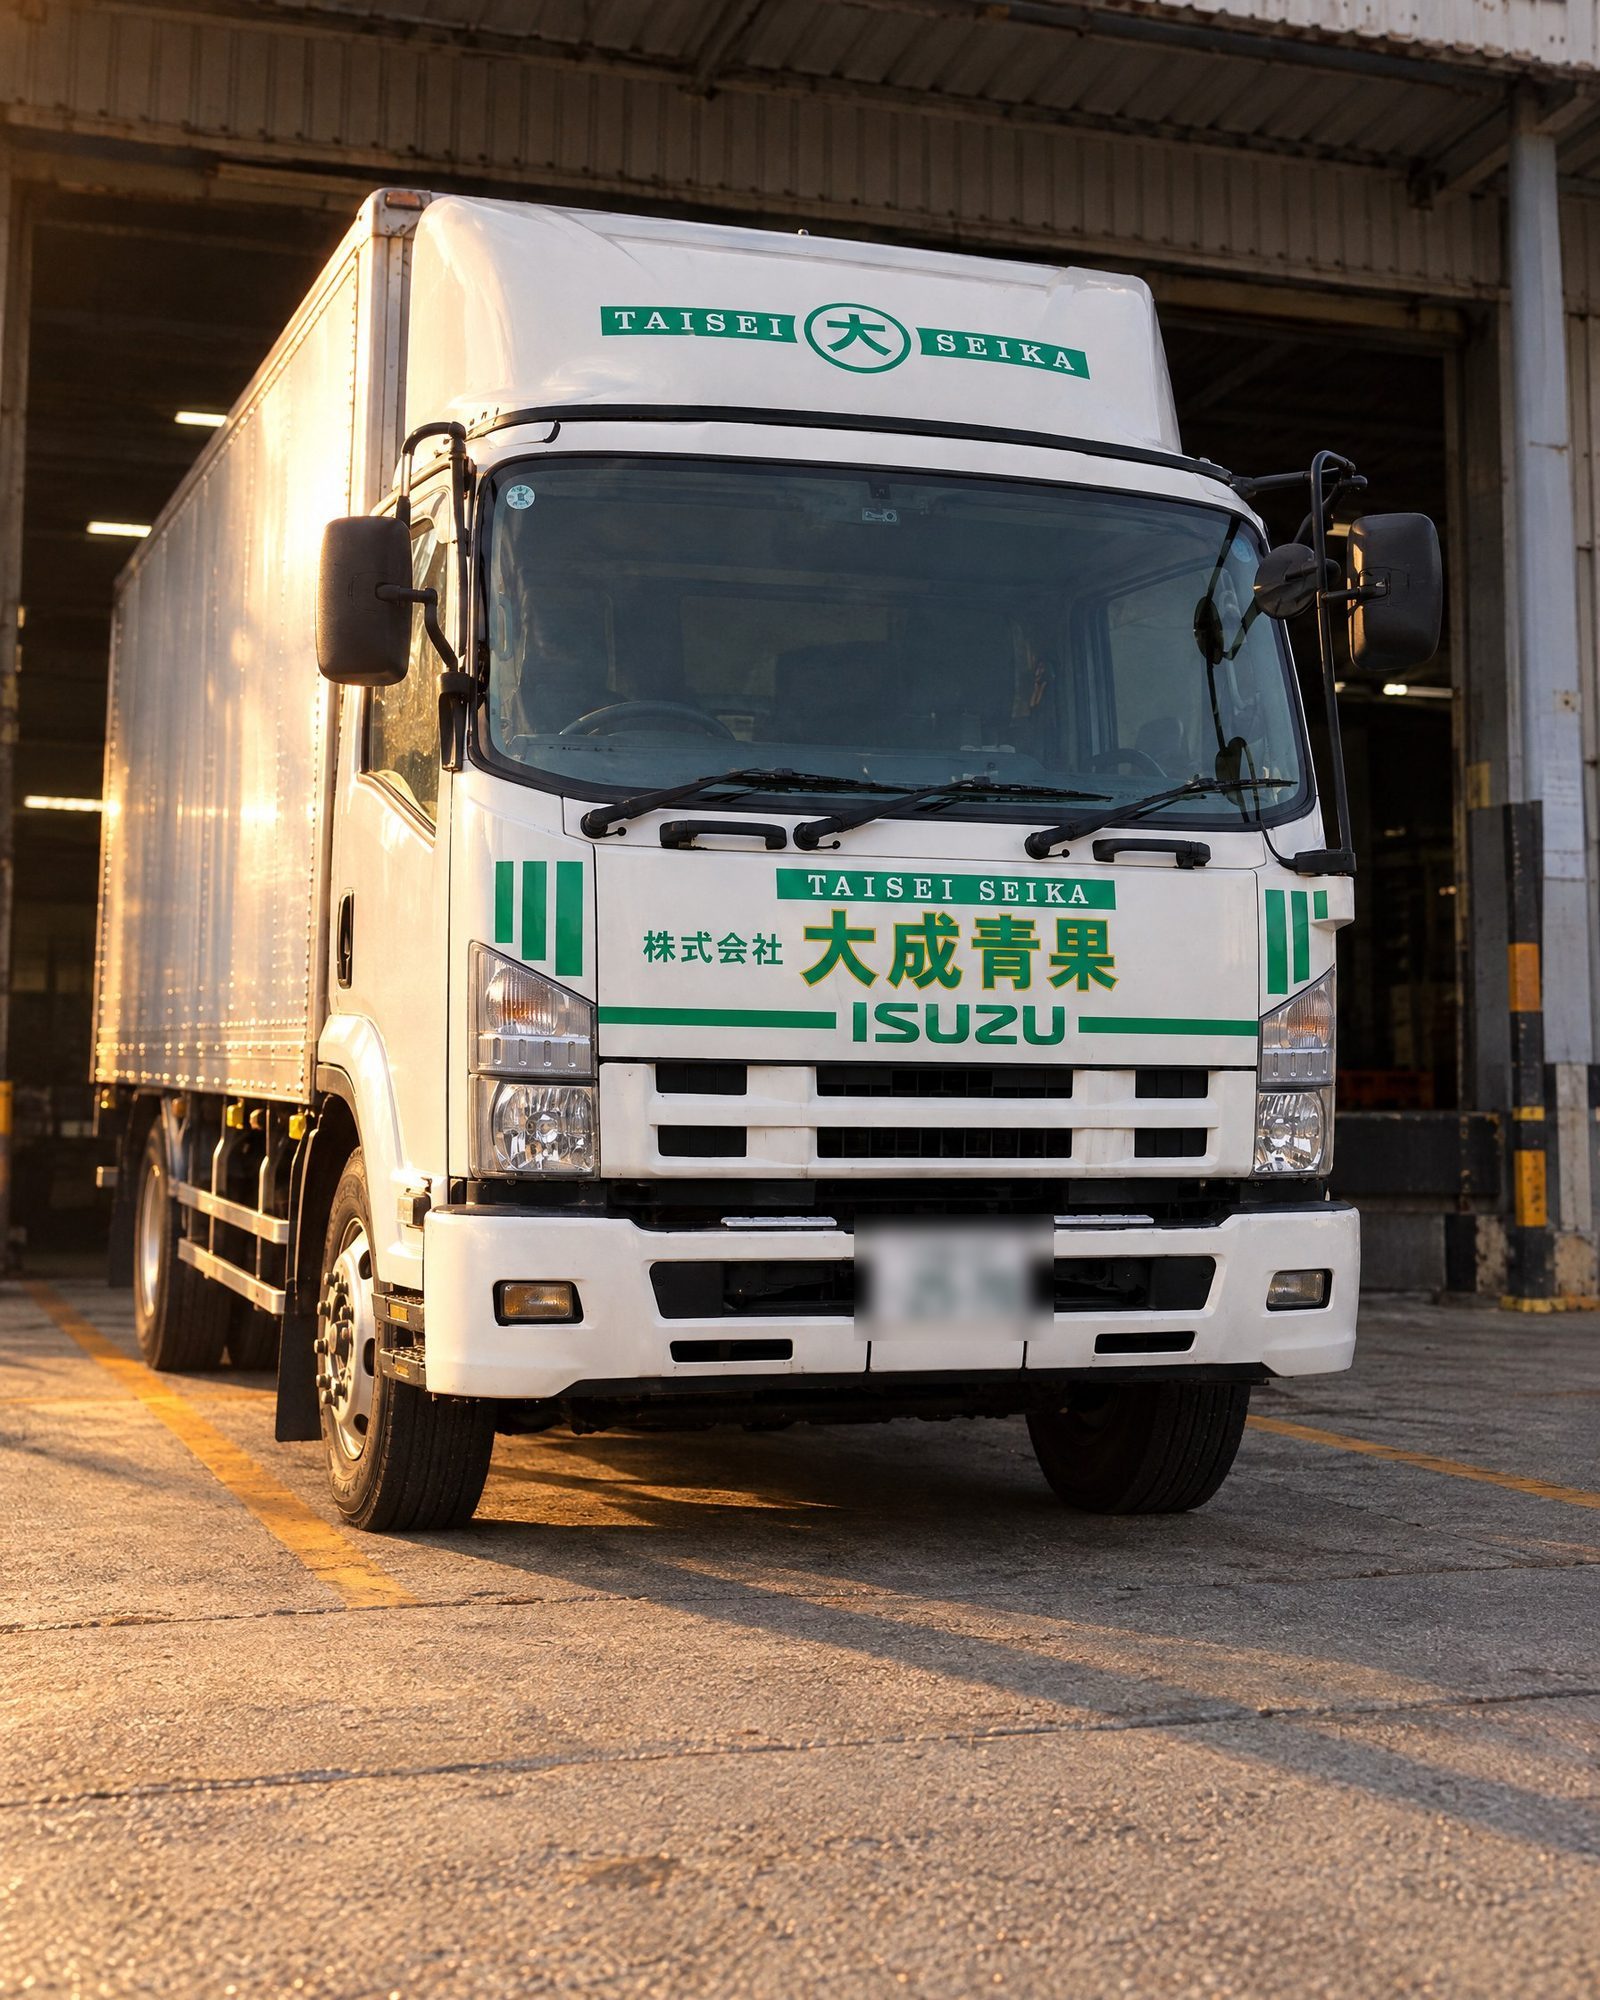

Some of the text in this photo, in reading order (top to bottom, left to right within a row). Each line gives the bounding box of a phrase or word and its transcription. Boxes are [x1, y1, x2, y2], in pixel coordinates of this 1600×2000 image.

[614, 311, 784, 337] TAISEI
[826, 313, 892, 357] 大
[936, 333, 1076, 372] SEIKA
[807, 875, 1090, 905] TAISEI SEIKA
[643, 930, 784, 966] 株式会社
[799, 908, 1120, 993] 大成青果
[852, 1002, 1066, 1046] ISUZU
